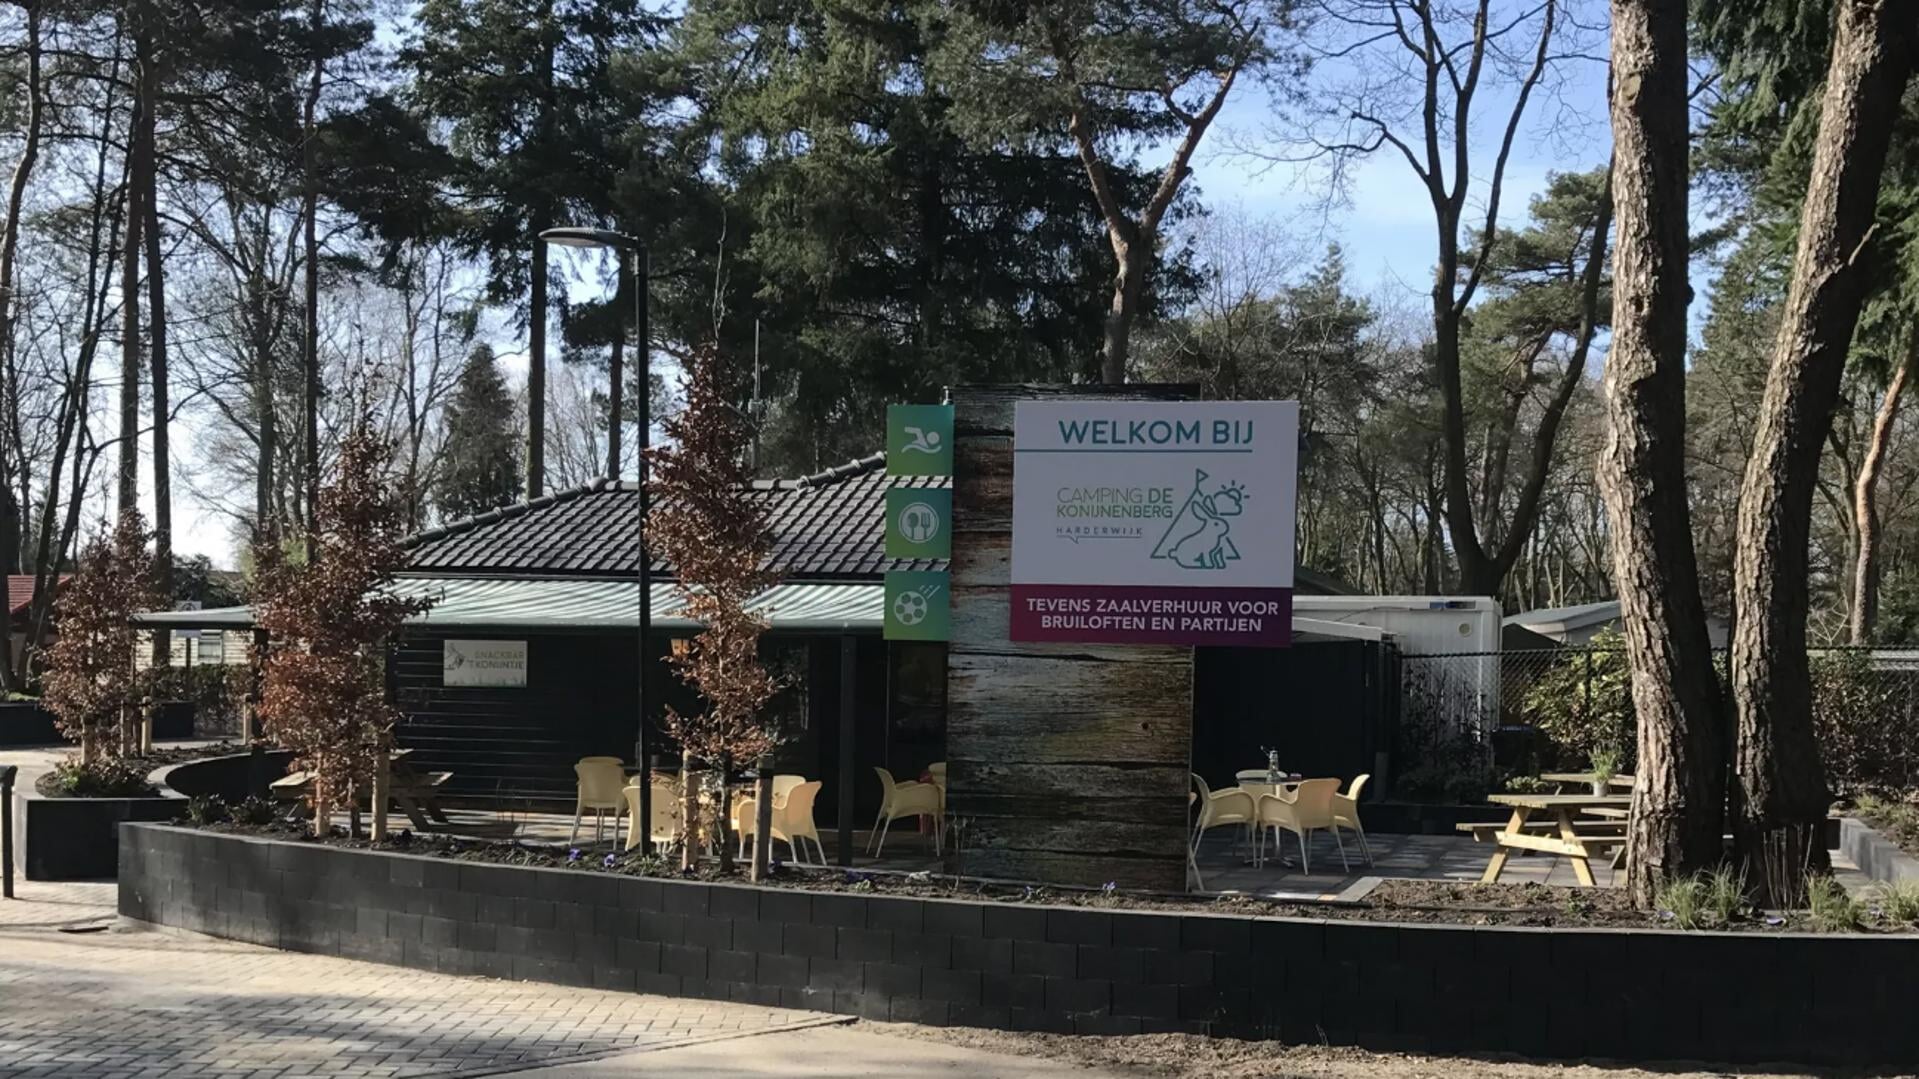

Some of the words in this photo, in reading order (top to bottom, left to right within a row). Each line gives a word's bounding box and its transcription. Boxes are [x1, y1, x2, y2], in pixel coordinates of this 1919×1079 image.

[1058, 420, 1200, 445] WELKOM
[1212, 420, 1254, 445] BIJ
[1057, 487, 1143, 504] CAMPING
[1148, 487, 1173, 504] DE
[1057, 504, 1173, 518] KONIJNENBERG
[1056, 526, 1142, 535] HARDERWIJK
[1027, 598, 1090, 612] TEVENS
[1097, 599, 1222, 615] ZAALVERHUUR
[1227, 601, 1278, 616] VOOR
[1041, 615, 1145, 630] BRUILOFTEN
[1151, 617, 1174, 631] EN
[1181, 617, 1262, 632] PARTIJEN
